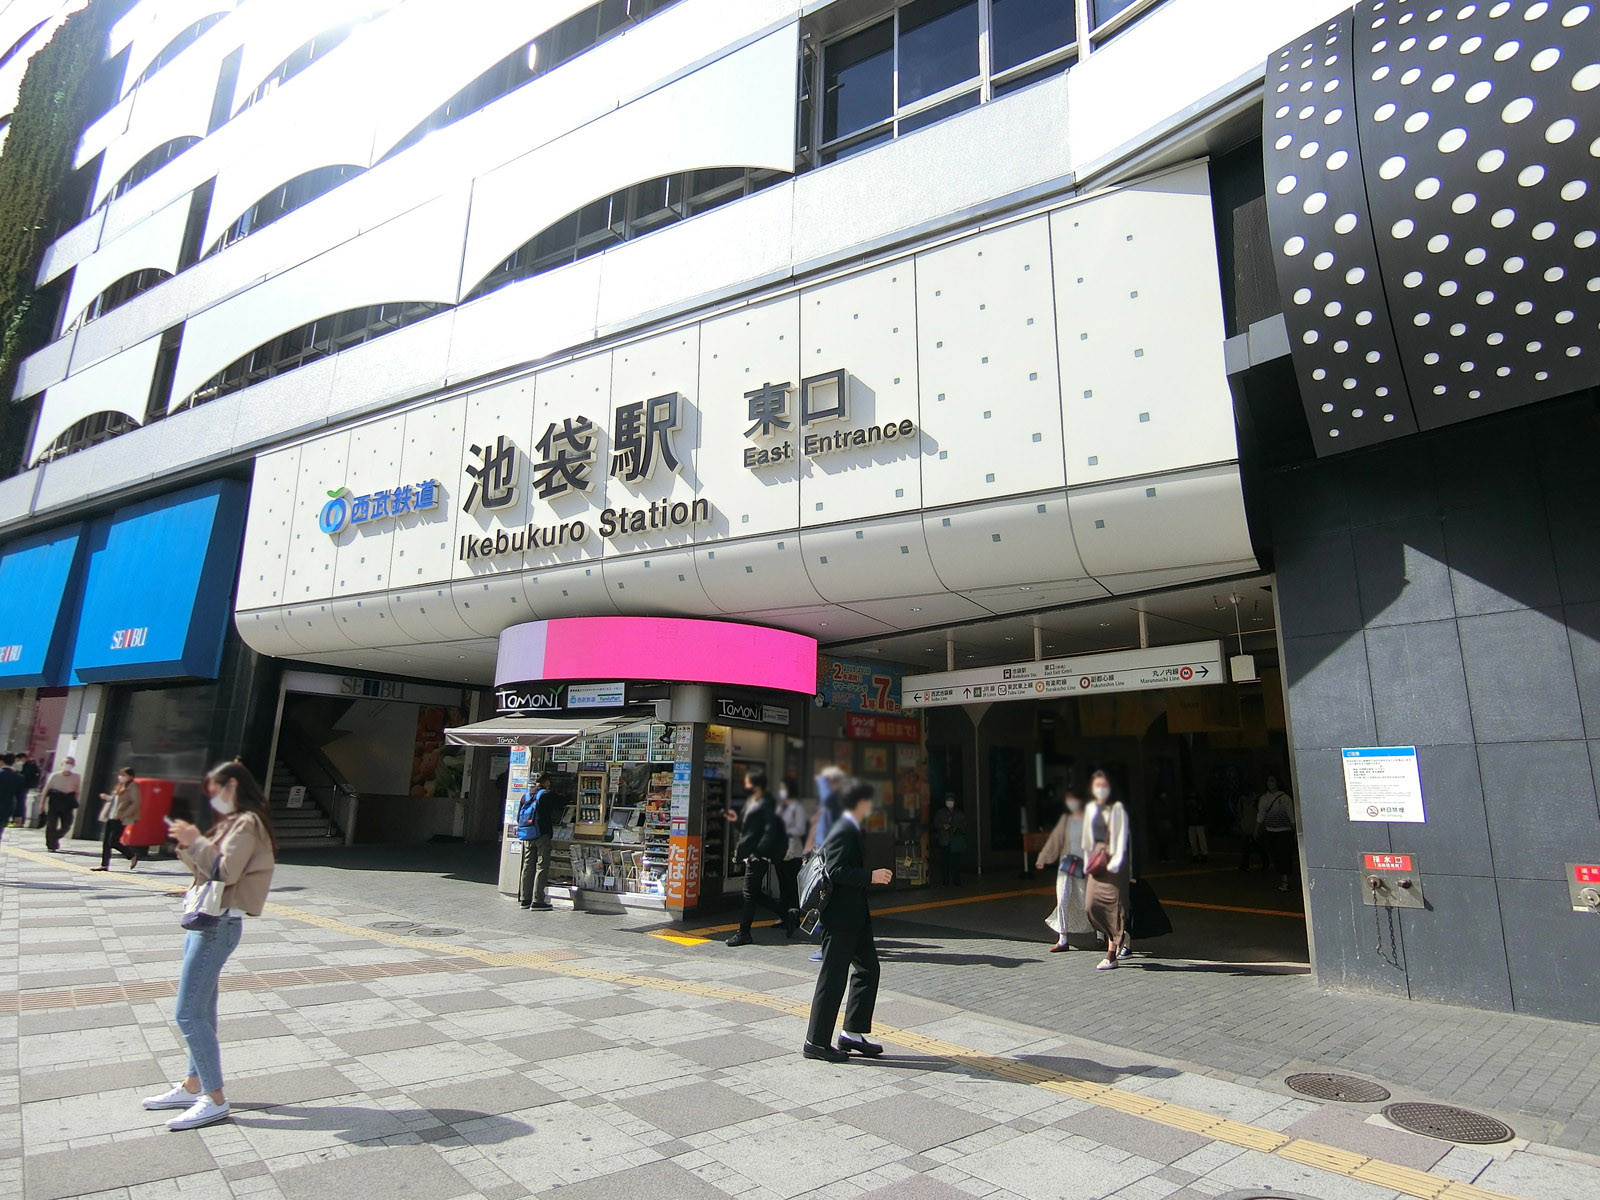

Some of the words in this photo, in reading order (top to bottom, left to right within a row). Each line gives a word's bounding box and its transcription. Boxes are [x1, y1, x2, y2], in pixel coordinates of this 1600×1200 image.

[743, 367, 849, 439] 東口
[462, 391, 682, 515] 池袋駅
[743, 441, 793, 469] East
[804, 419, 915, 457] Entrance
[351, 479, 438, 524] 西武鉄道
[460, 520, 586, 562] Ikebukuro
[599, 498, 712, 538] Station
[110, 627, 148, 650] SEIBU
[340, 677, 404, 699] SEIBU
[1152, 669, 1179, 677] 丸ノ内線
[668, 843, 685, 899] たばこ
[686, 844, 699, 898] たばこ
